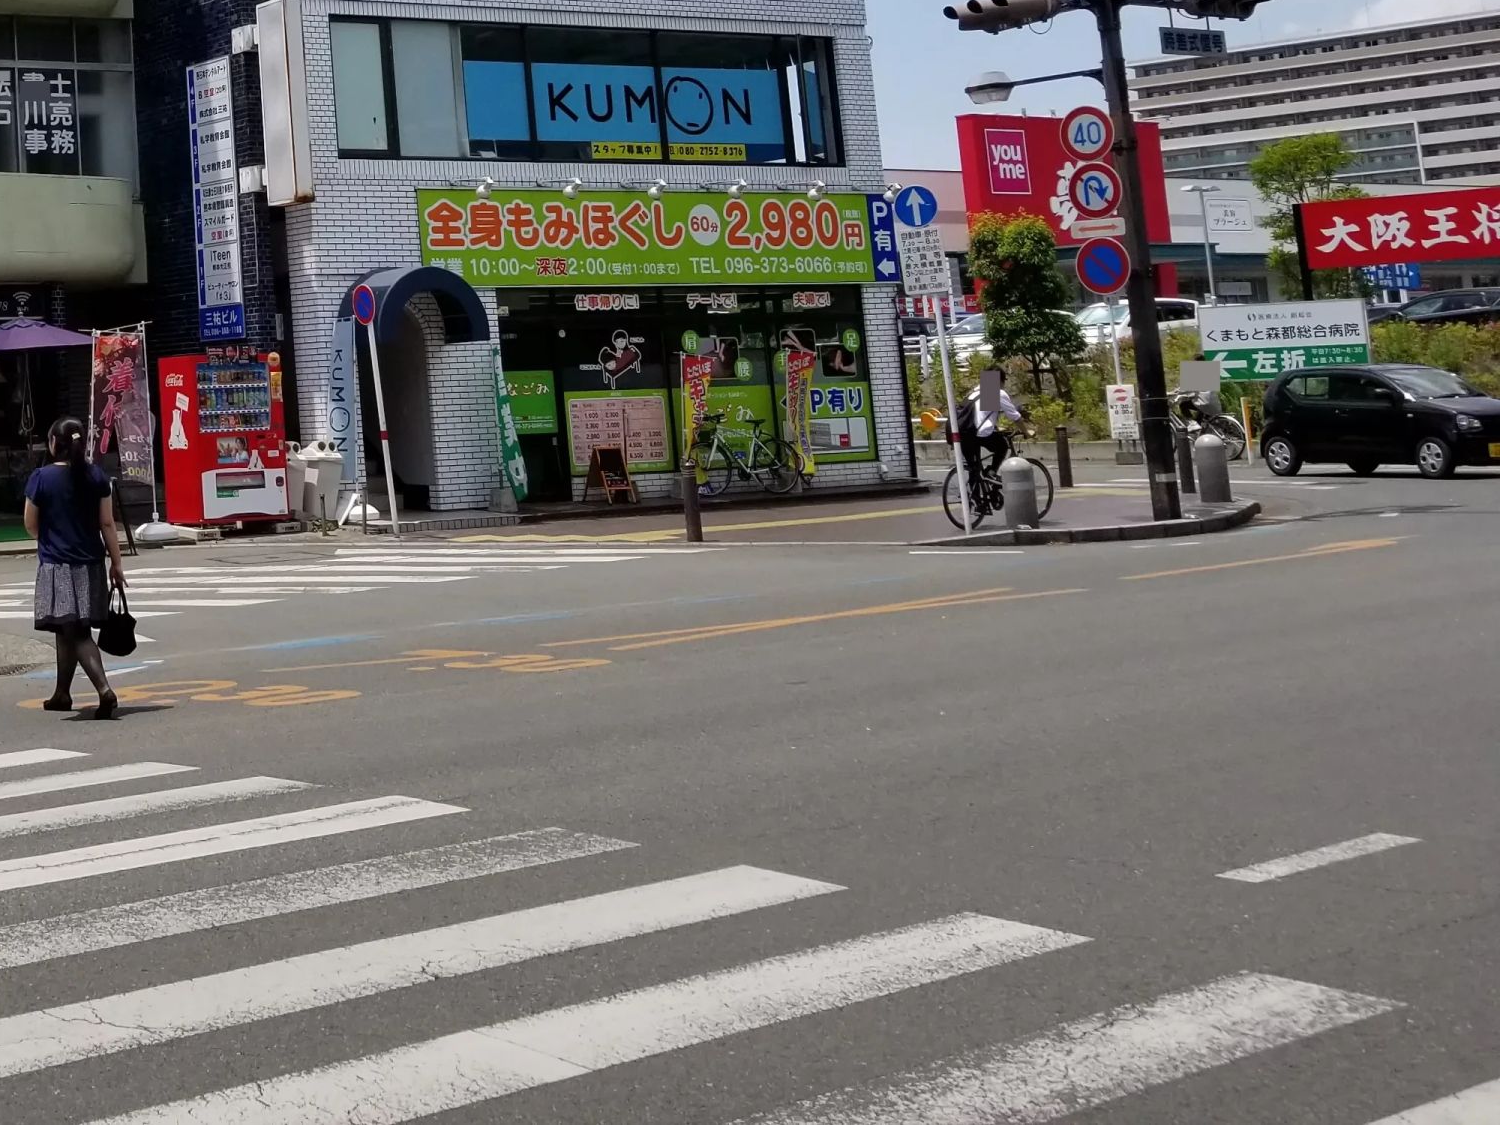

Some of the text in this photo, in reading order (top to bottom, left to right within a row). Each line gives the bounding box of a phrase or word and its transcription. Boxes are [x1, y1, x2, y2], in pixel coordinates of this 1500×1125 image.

[547, 75, 752, 136] KUMON
[1073, 121, 1102, 147] 40
[991, 143, 1022, 164] you
[999, 162, 1025, 180] me
[425, 198, 685, 251] 全身もみほぐし
[690, 216, 719, 233] 60分
[689, 257, 721, 274] TEL
[1206, 323, 1361, 343] くまもと森都総合病院
[1252, 349, 1306, 374] 左折
[329, 349, 351, 453] KUMON
[810, 386, 863, 415] P有り
